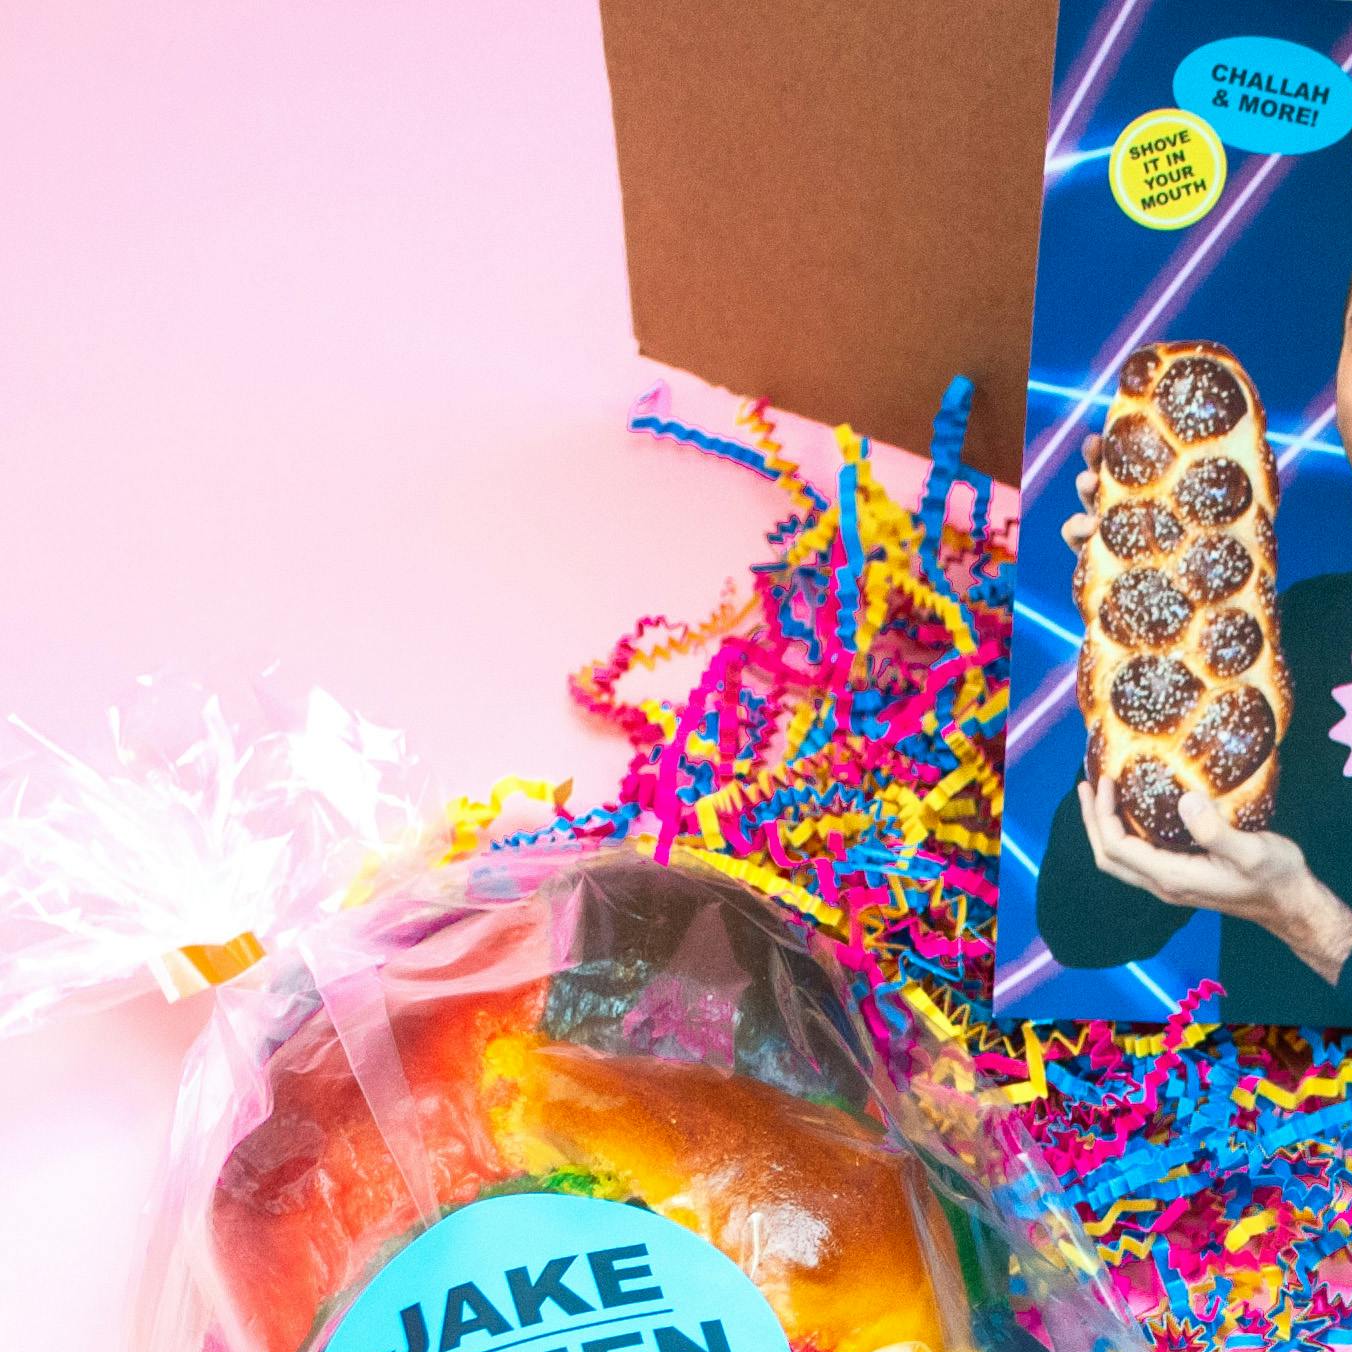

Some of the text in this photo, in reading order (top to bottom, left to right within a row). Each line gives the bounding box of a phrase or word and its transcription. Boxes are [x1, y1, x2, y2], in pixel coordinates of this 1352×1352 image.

[1211, 63, 1330, 105] CHALLAH
[1211, 89, 1320, 128] & MORE!
[1128, 130, 1191, 161] SHOVE
[1143, 149, 1186, 174] IT IN
[1144, 165, 1194, 191] YOUR
[1140, 179, 1207, 211] MOUTH
